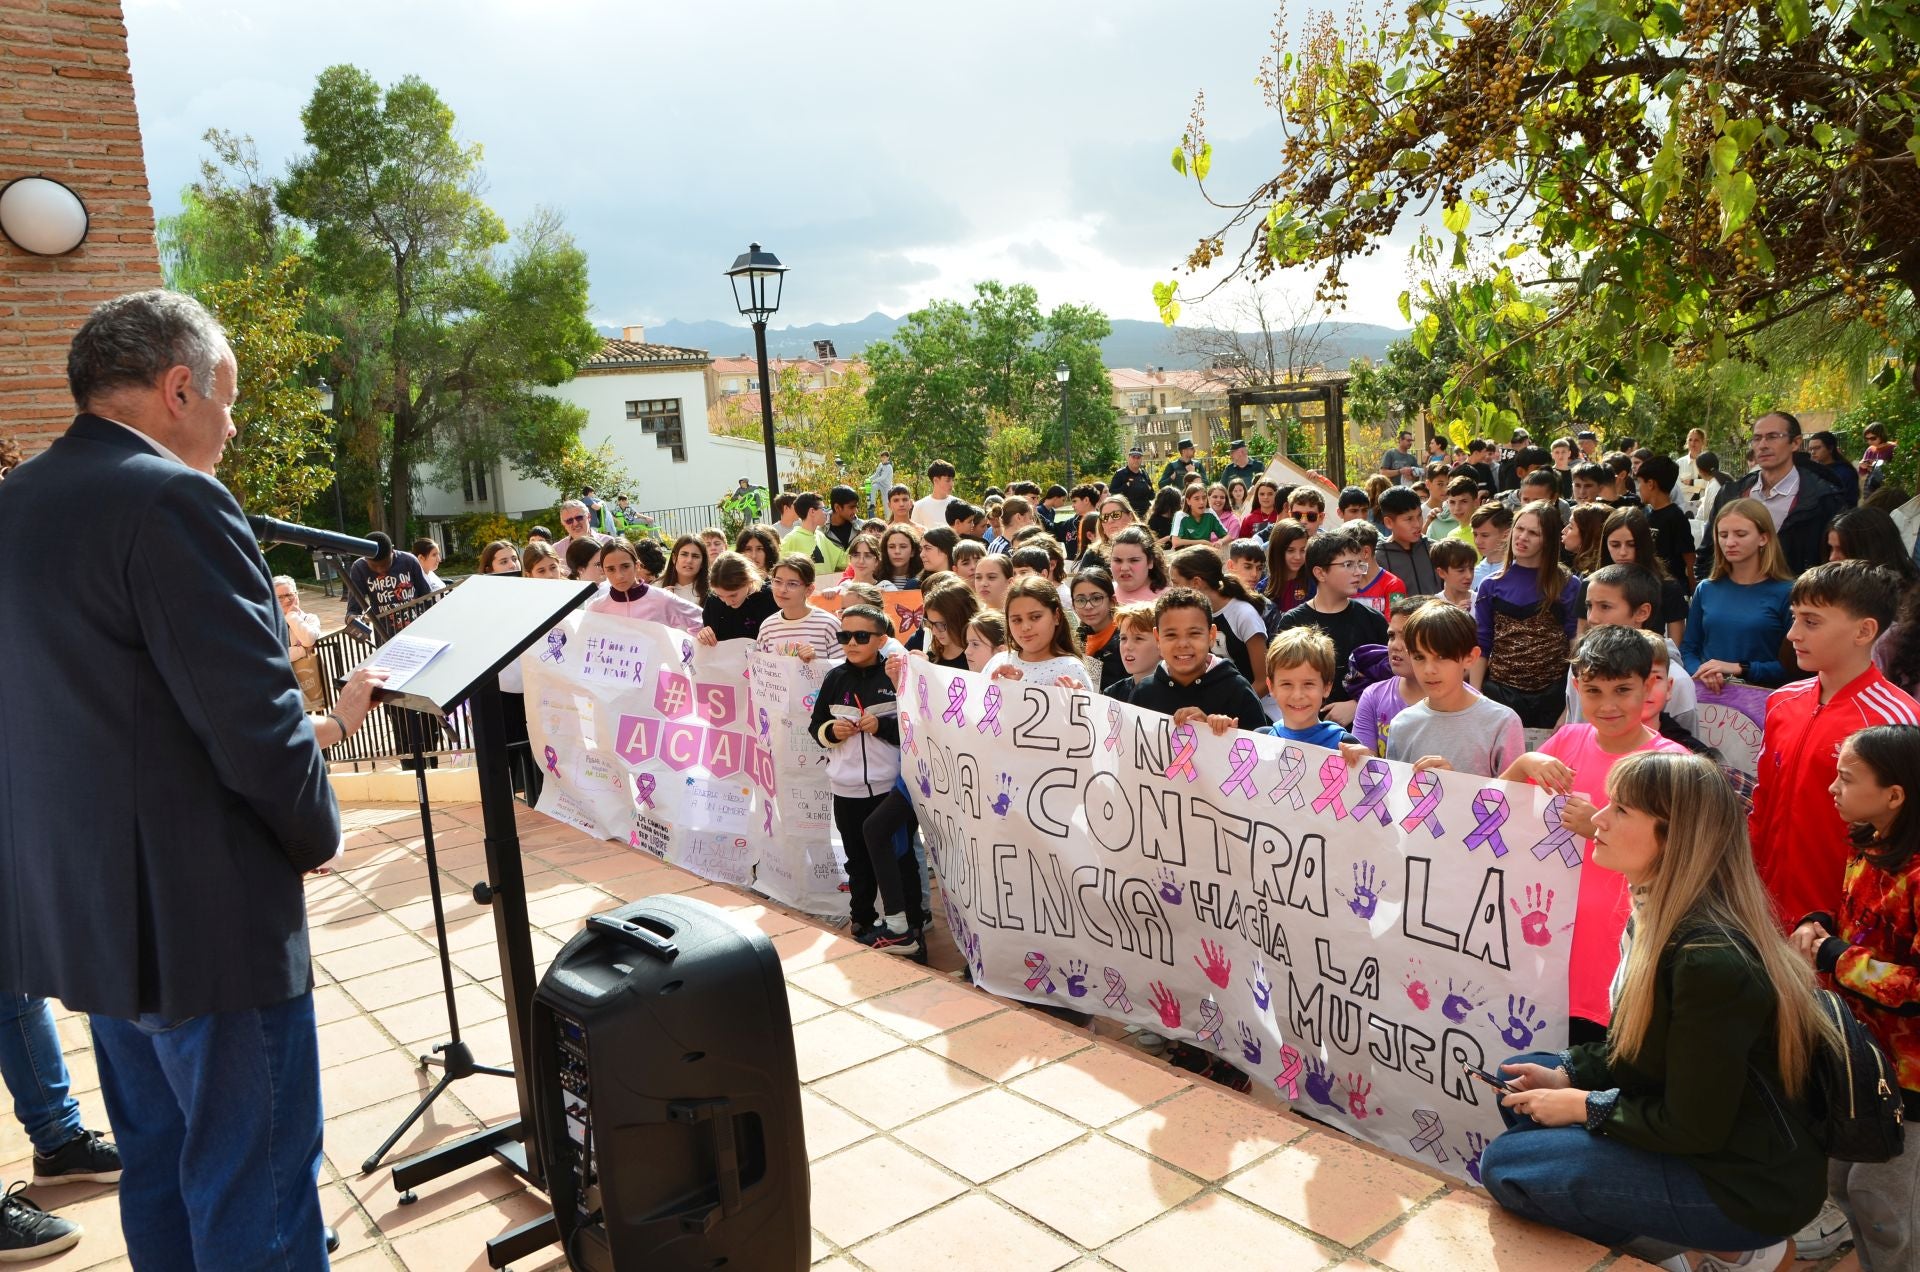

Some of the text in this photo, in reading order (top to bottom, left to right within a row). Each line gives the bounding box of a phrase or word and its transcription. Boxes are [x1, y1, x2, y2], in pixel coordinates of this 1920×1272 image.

[367, 571, 411, 592] SHRED ON
[377, 590, 394, 603] OFF
[1013, 687, 1174, 778] 25 N
[919, 803, 1175, 966] VIOLENCIA
[1315, 938, 1380, 1001] LA
[926, 736, 1511, 971] DIA CONTRA LA
[1288, 972, 1485, 1106] MUJER
